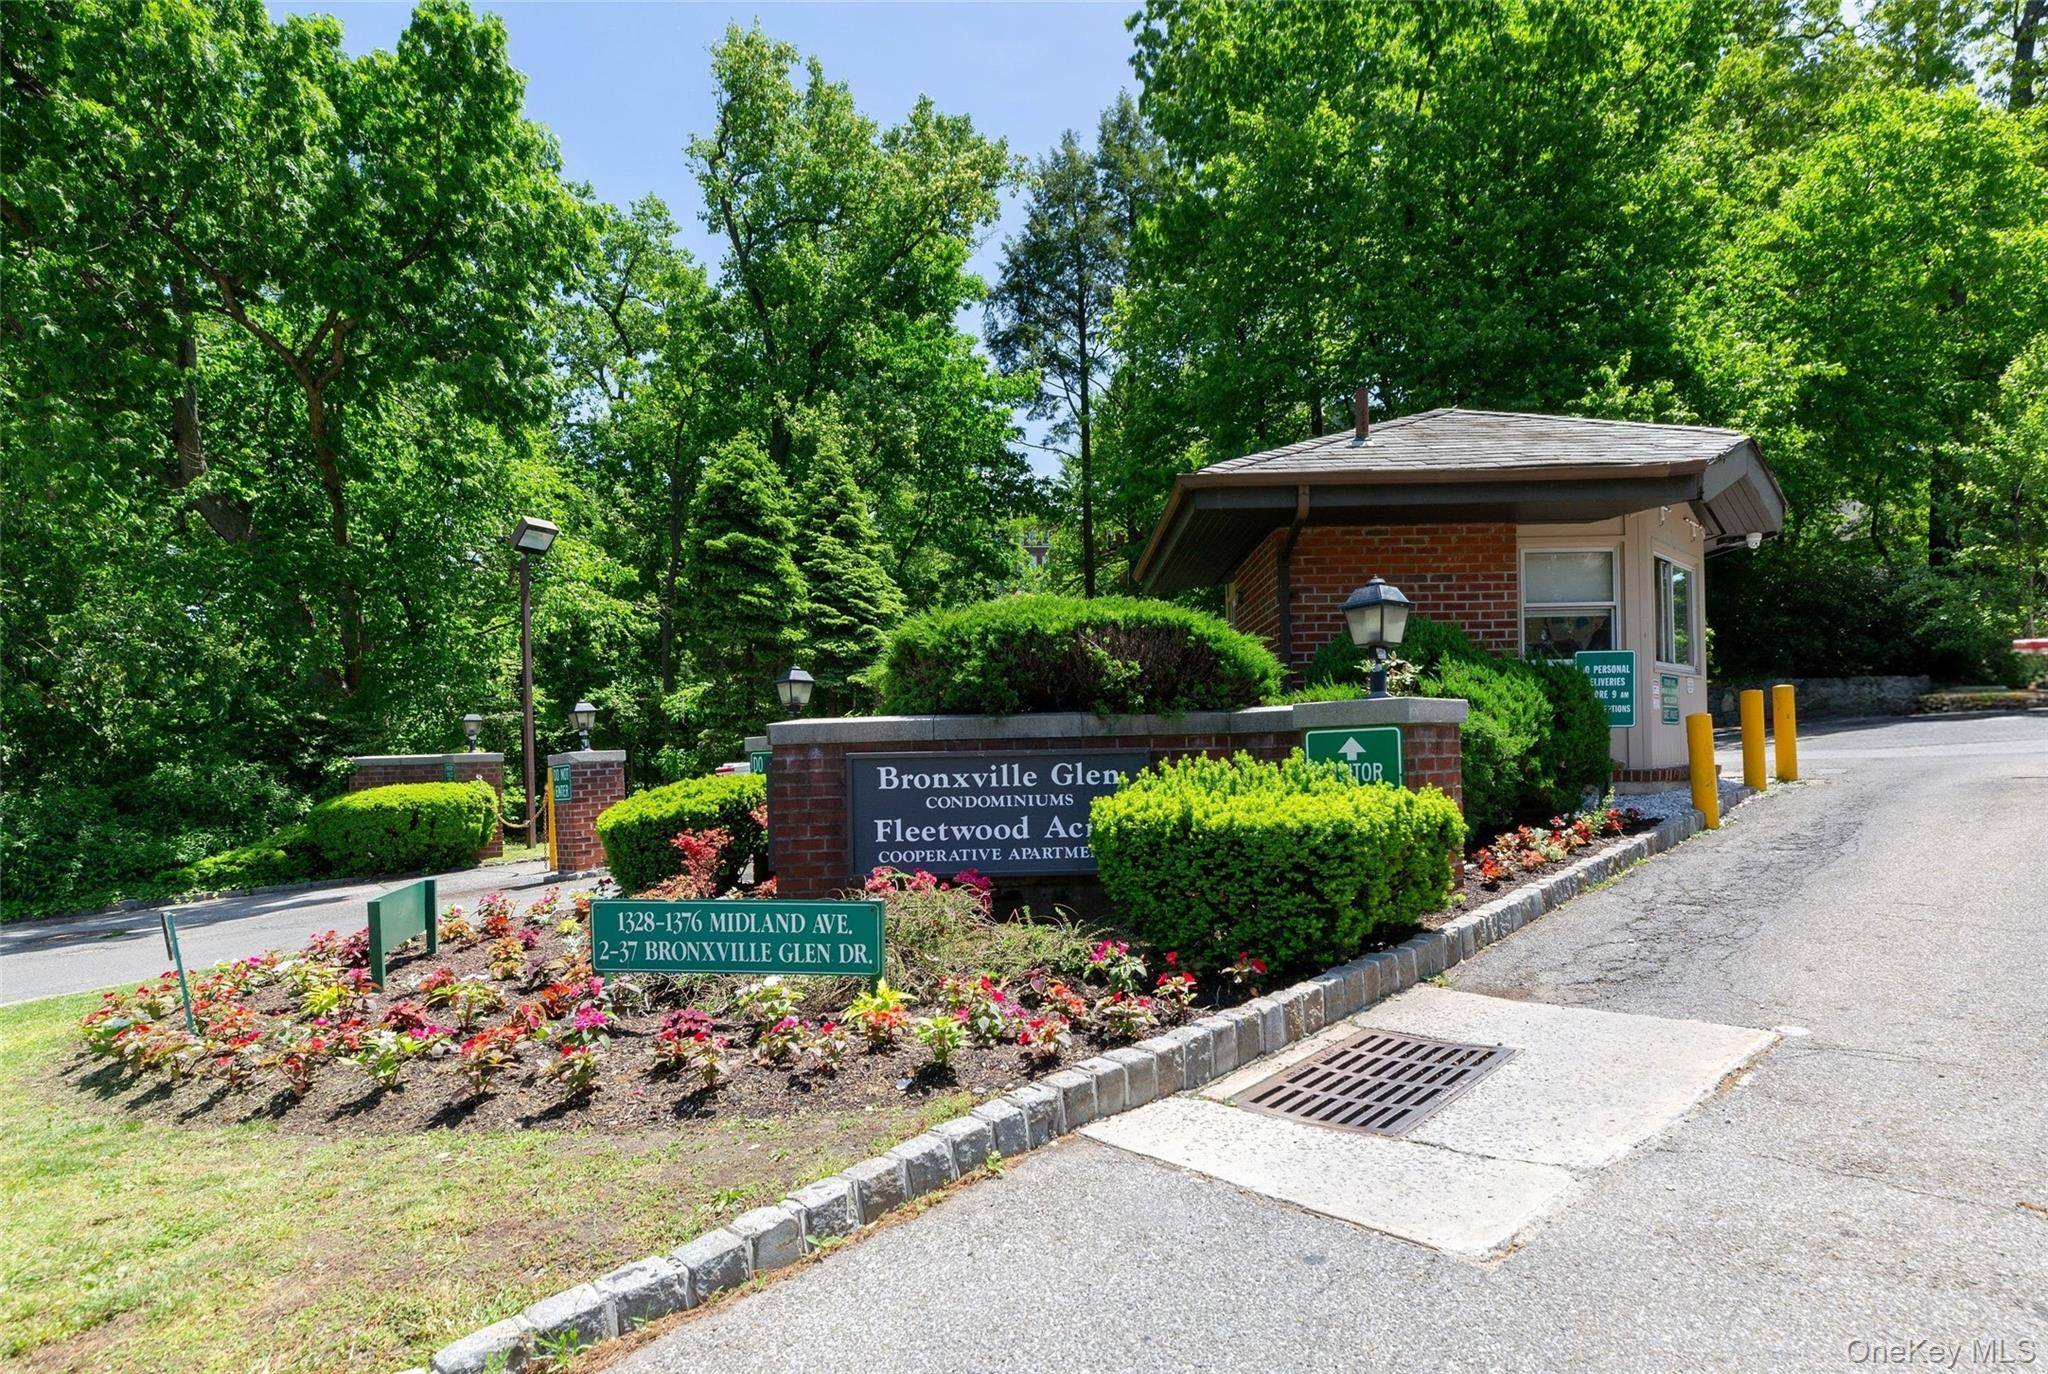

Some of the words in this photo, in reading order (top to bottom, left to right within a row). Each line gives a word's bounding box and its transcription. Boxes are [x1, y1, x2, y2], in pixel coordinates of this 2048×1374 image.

[1593, 664, 1631, 674] PERSONAL
[1590, 677, 1626, 687] ELIVERIES
[1594, 690, 1608, 699] ORE
[1611, 690, 1617, 699] 9
[876, 763, 1038, 790] Bronxville
[1050, 761, 1120, 787] Glen
[925, 793, 1075, 810] CONDOMINIUMS
[874, 815, 1030, 843] Fleetwood
[1044, 815, 1093, 839] Acr
[878, 848, 1002, 864] COOPERATIVE
[1008, 845, 1095, 861] APARTME
[617, 911, 703, 935] 1328-1376
[710, 913, 806, 935] MIDLAND
[812, 913, 853, 935] AVE.
[600, 941, 638, 964] 2-37
[645, 941, 772, 964] BRONXVILLE
[779, 943, 831, 964] GLEN
[839, 943, 873, 965] DR.
